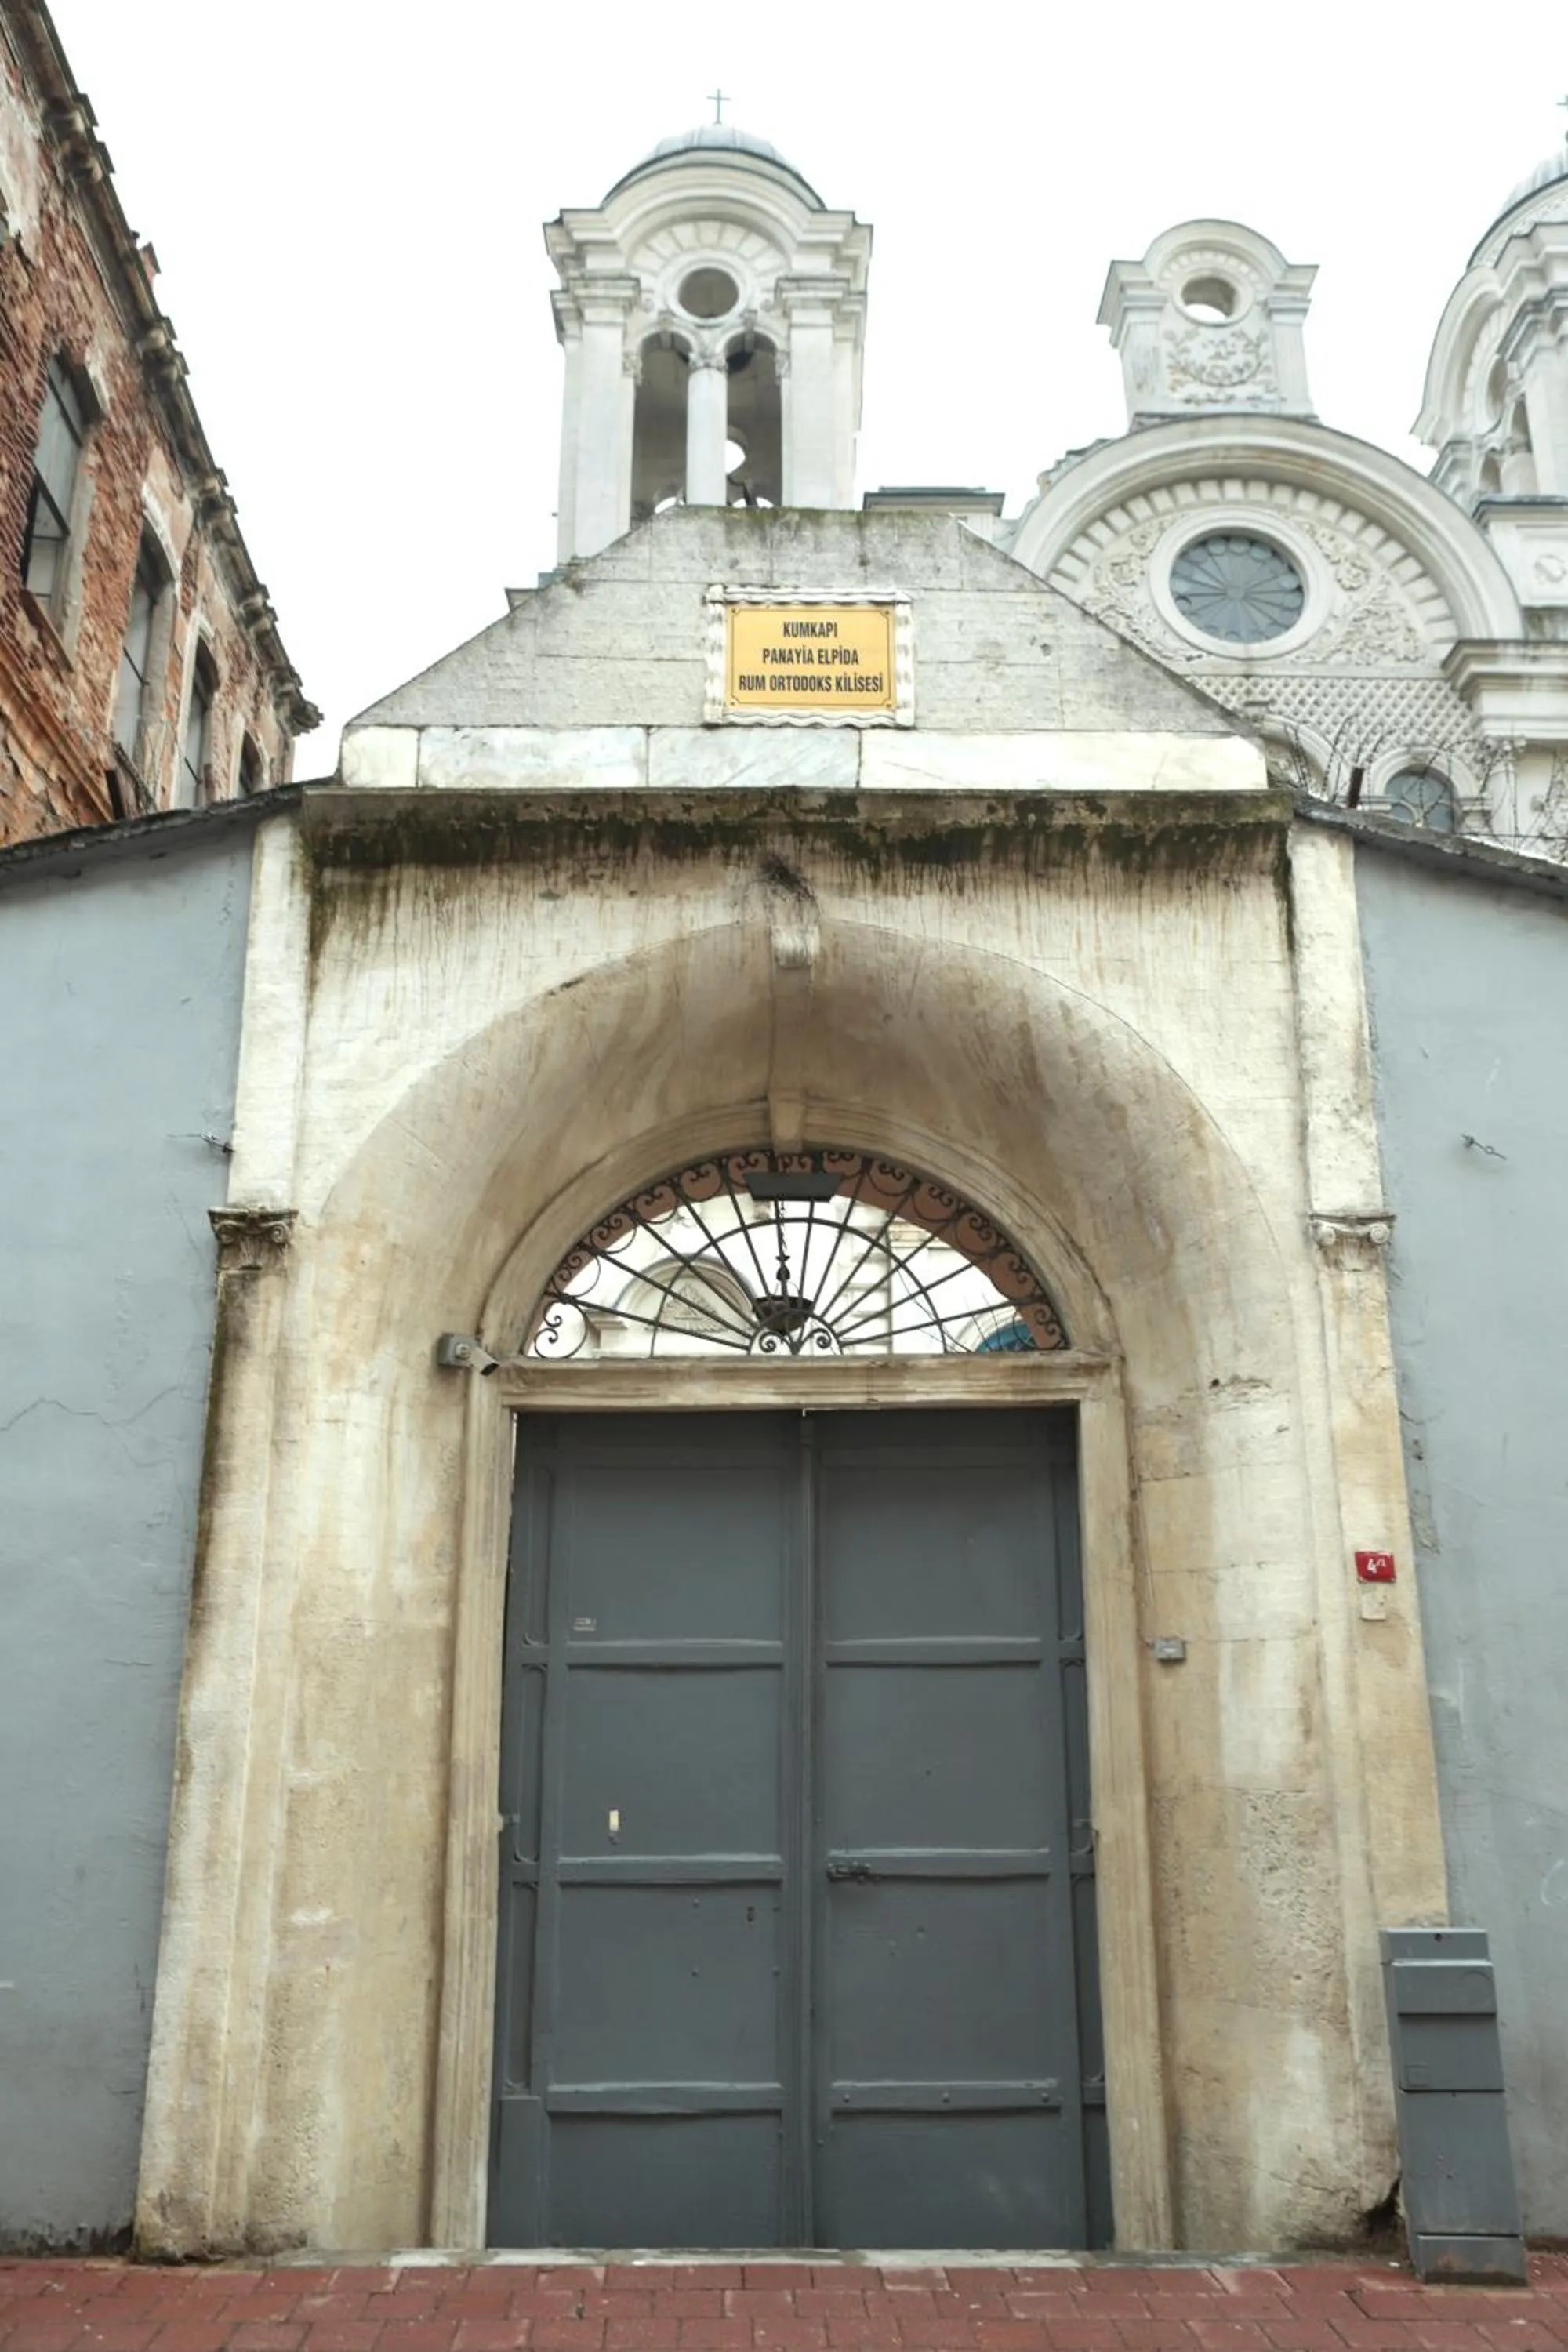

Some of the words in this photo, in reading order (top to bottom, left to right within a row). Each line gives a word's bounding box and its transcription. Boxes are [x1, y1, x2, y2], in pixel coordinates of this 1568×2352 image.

[783, 622, 837, 637] KUMKAPI
[763, 645, 814, 665] PANAYİA
[818, 645, 859, 665] ELPİDA
[739, 675, 765, 691] RUM
[769, 675, 832, 691] ORTODOKS
[835, 672, 883, 692] KİLİSESİ
